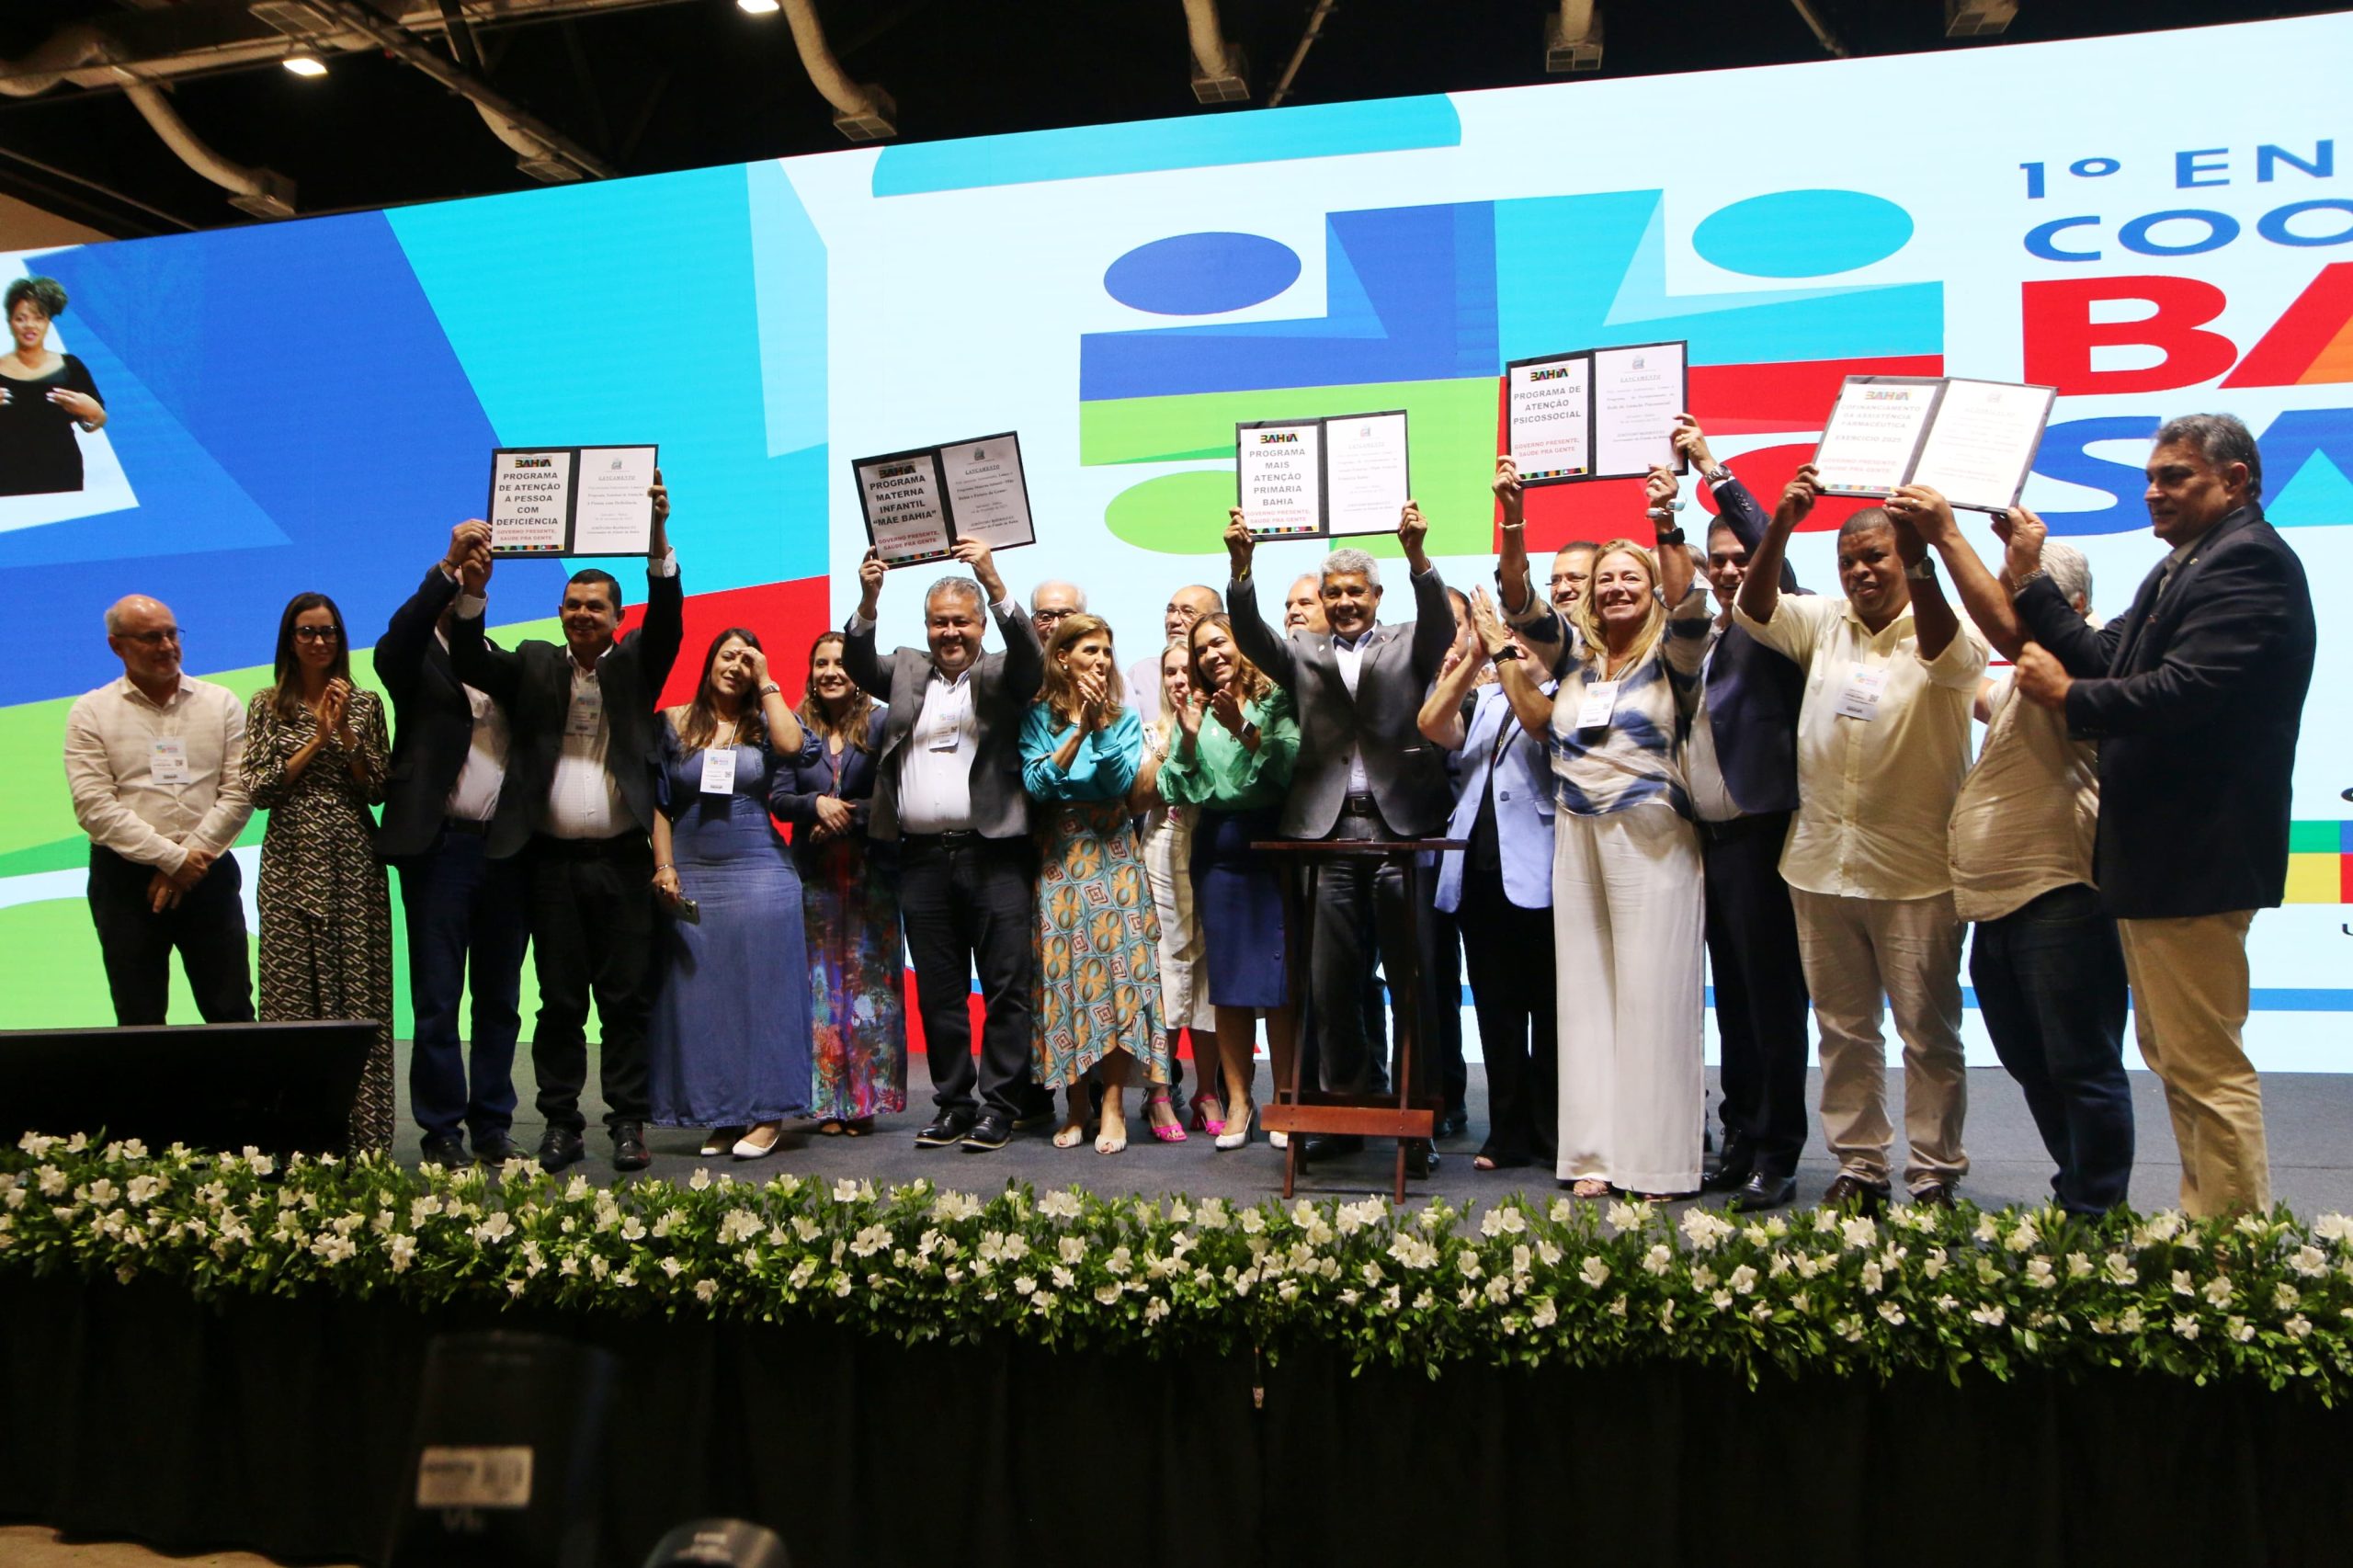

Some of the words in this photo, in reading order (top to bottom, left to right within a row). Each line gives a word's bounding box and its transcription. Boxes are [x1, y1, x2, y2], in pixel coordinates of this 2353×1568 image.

[1514, 388, 1565, 401] PROGRAMA
[1525, 400, 1569, 411] ATENÇÃO
[1514, 411, 1581, 425] PSICOSSOCIAL
[1515, 441, 1544, 449] GOVERNO
[1250, 449, 1305, 458] PROGRAMA
[1254, 472, 1302, 482] ATENÇÃO
[515, 483, 561, 492] ATENÇÃO
[870, 475, 926, 491] PROGRAMA
[1254, 484, 1302, 494] PRIMÁRIA
[876, 488, 924, 502] MATERNA
[880, 500, 926, 514] INFANTIL
[496, 517, 558, 526] DEFICIÊNCIA
[878, 536, 906, 544] GOVERNO
